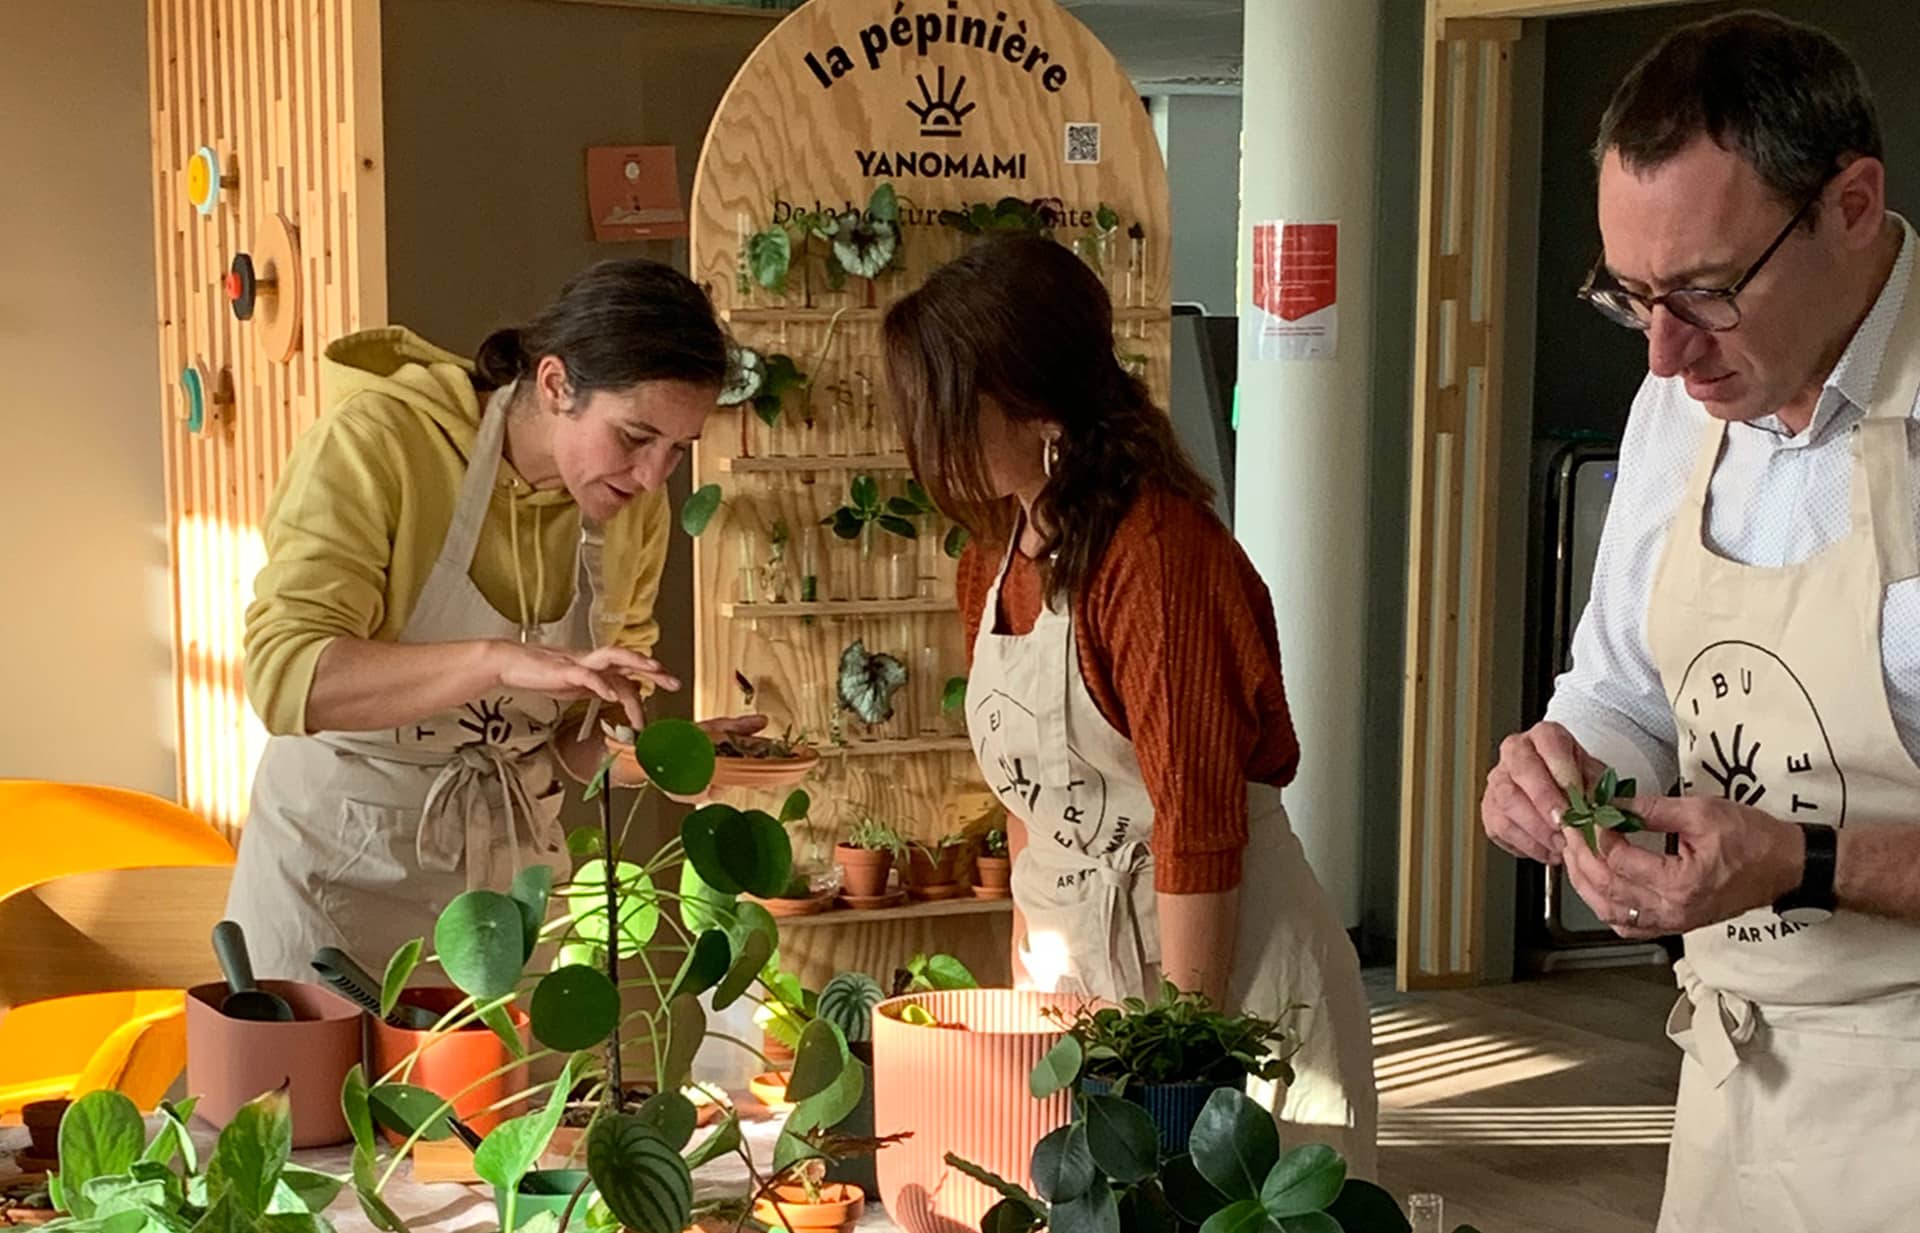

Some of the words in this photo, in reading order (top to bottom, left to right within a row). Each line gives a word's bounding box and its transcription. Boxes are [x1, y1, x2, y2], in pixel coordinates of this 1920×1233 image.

[804, 46, 855, 90] la
[860, 0, 1067, 92] pépinière
[856, 150, 1027, 180] YANOMAMI
[1727, 923, 1763, 943] PAR
